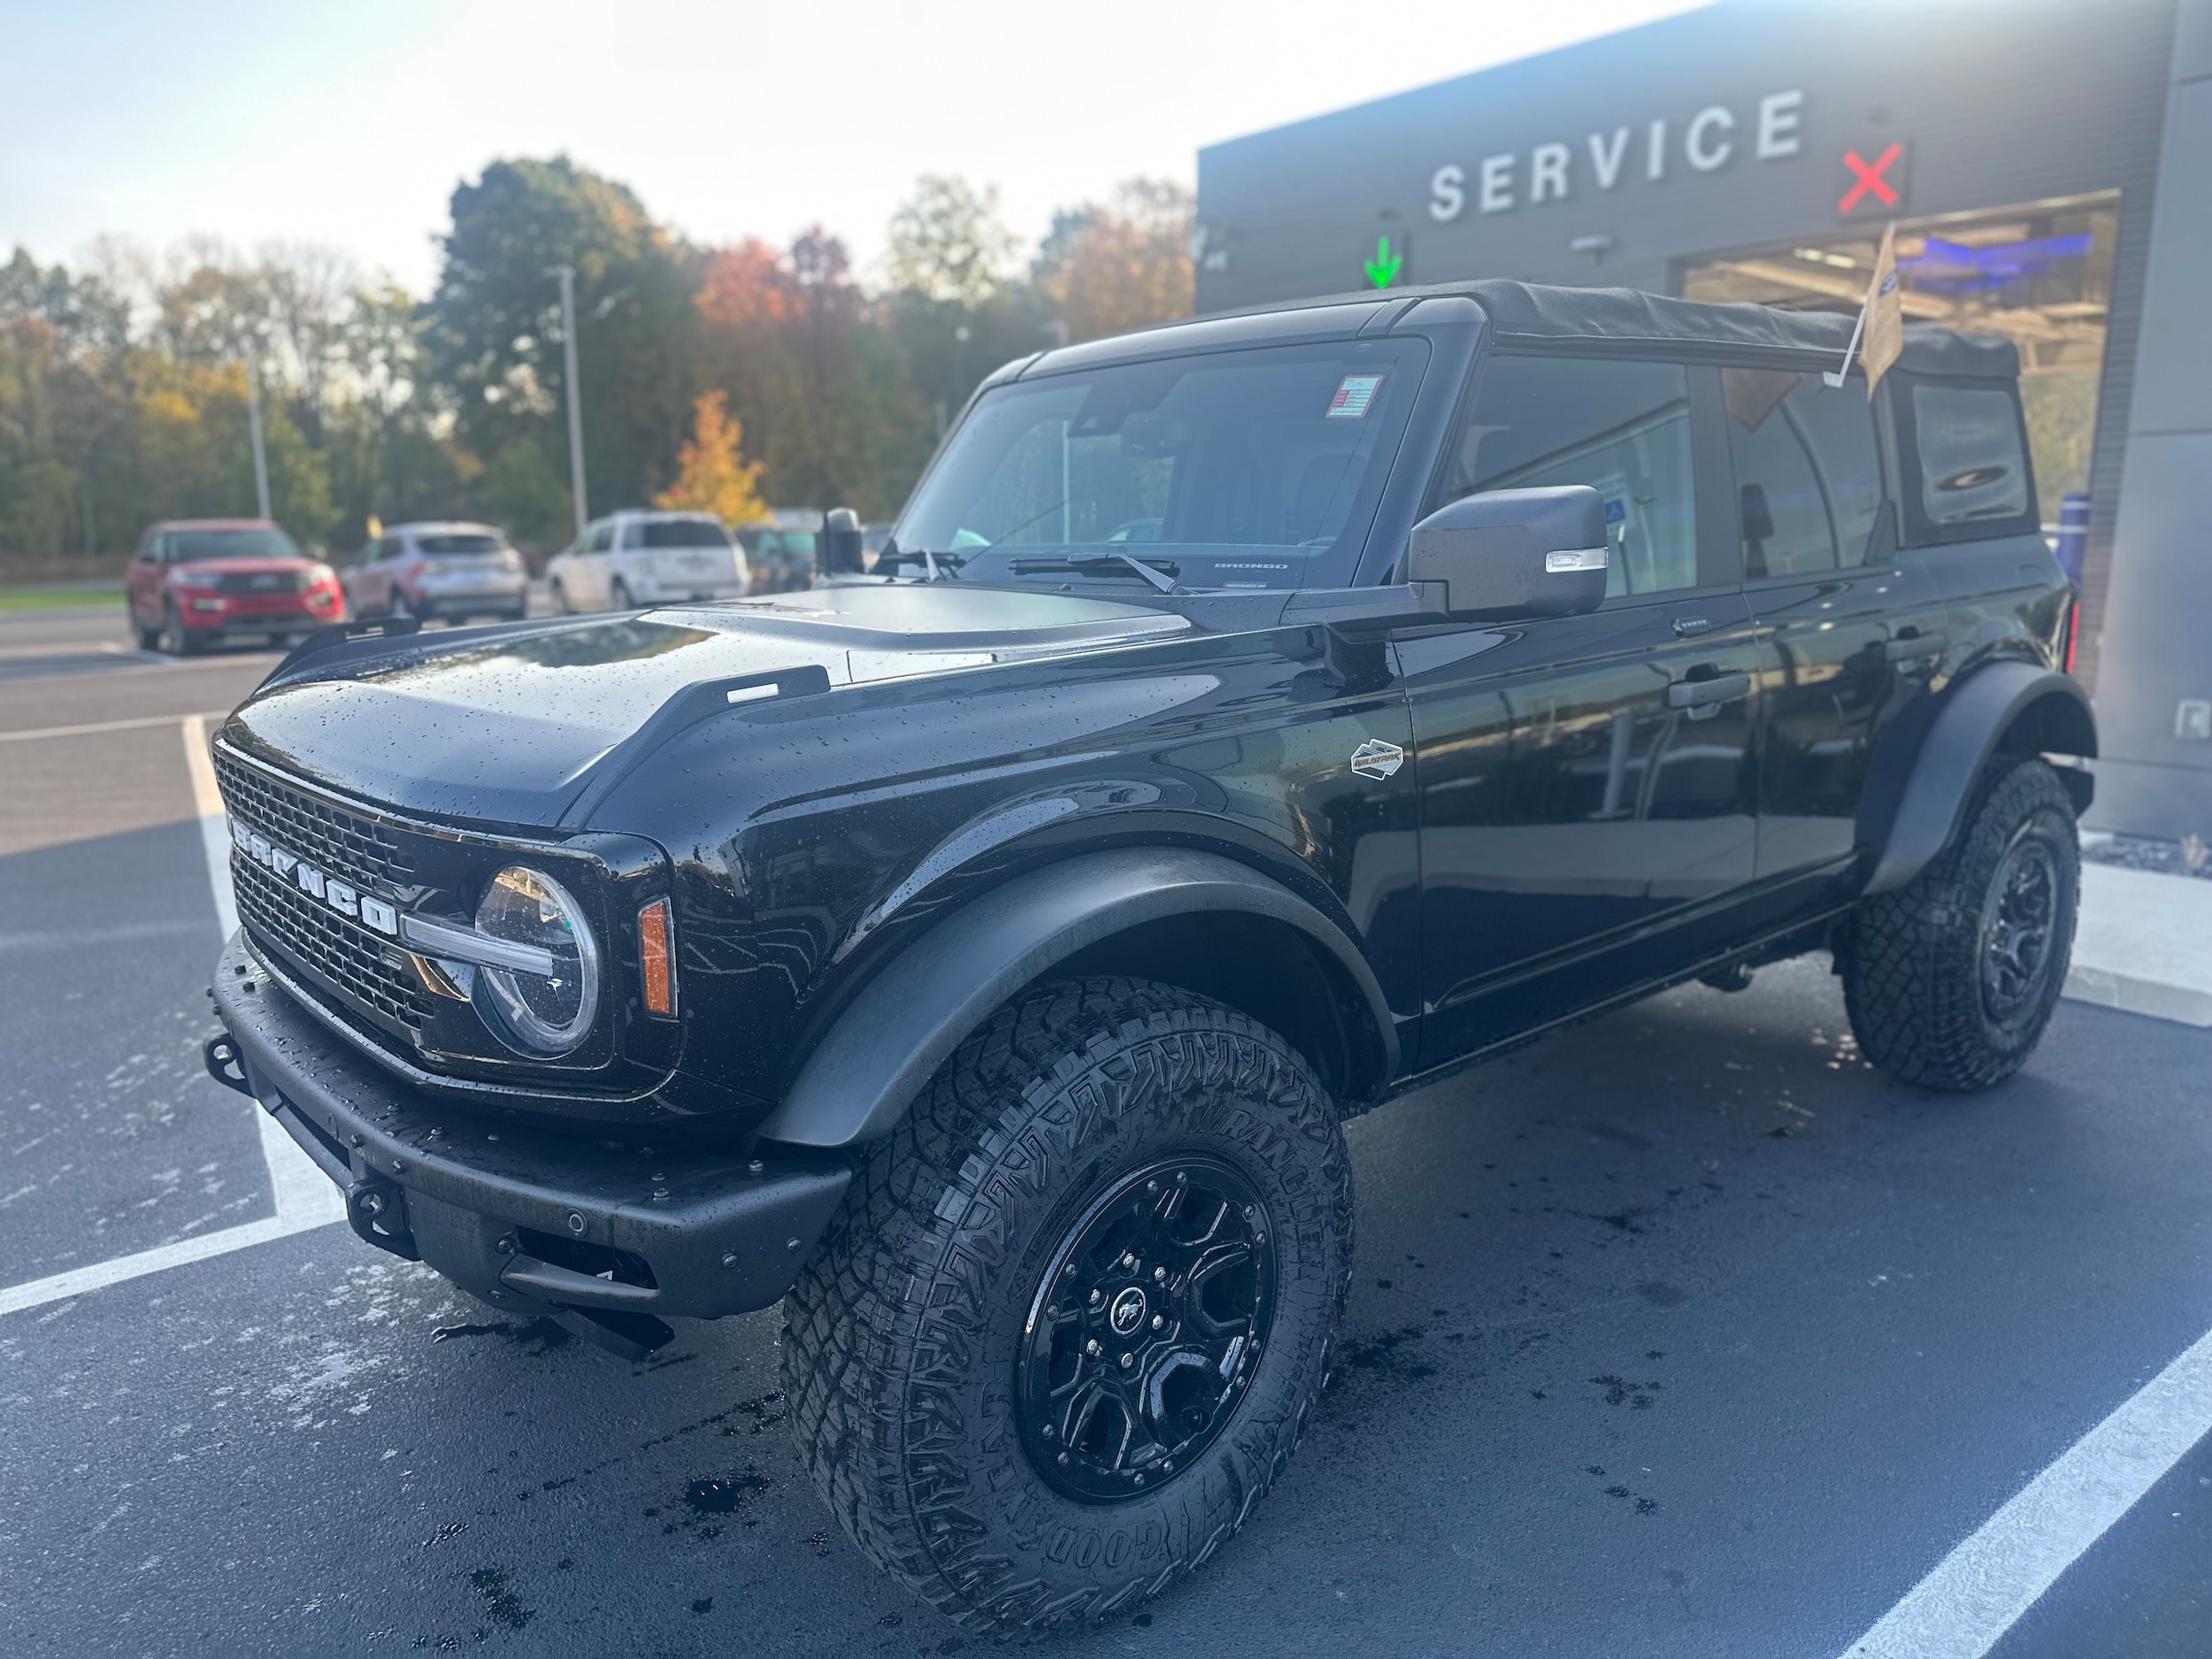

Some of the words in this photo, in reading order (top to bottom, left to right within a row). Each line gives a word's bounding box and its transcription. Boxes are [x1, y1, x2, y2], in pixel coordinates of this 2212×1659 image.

[1429, 89, 1804, 221] SERVICE
[1354, 753, 1401, 767] WILDTRAK
[1187, 1103, 1325, 1280] WRANGLER
